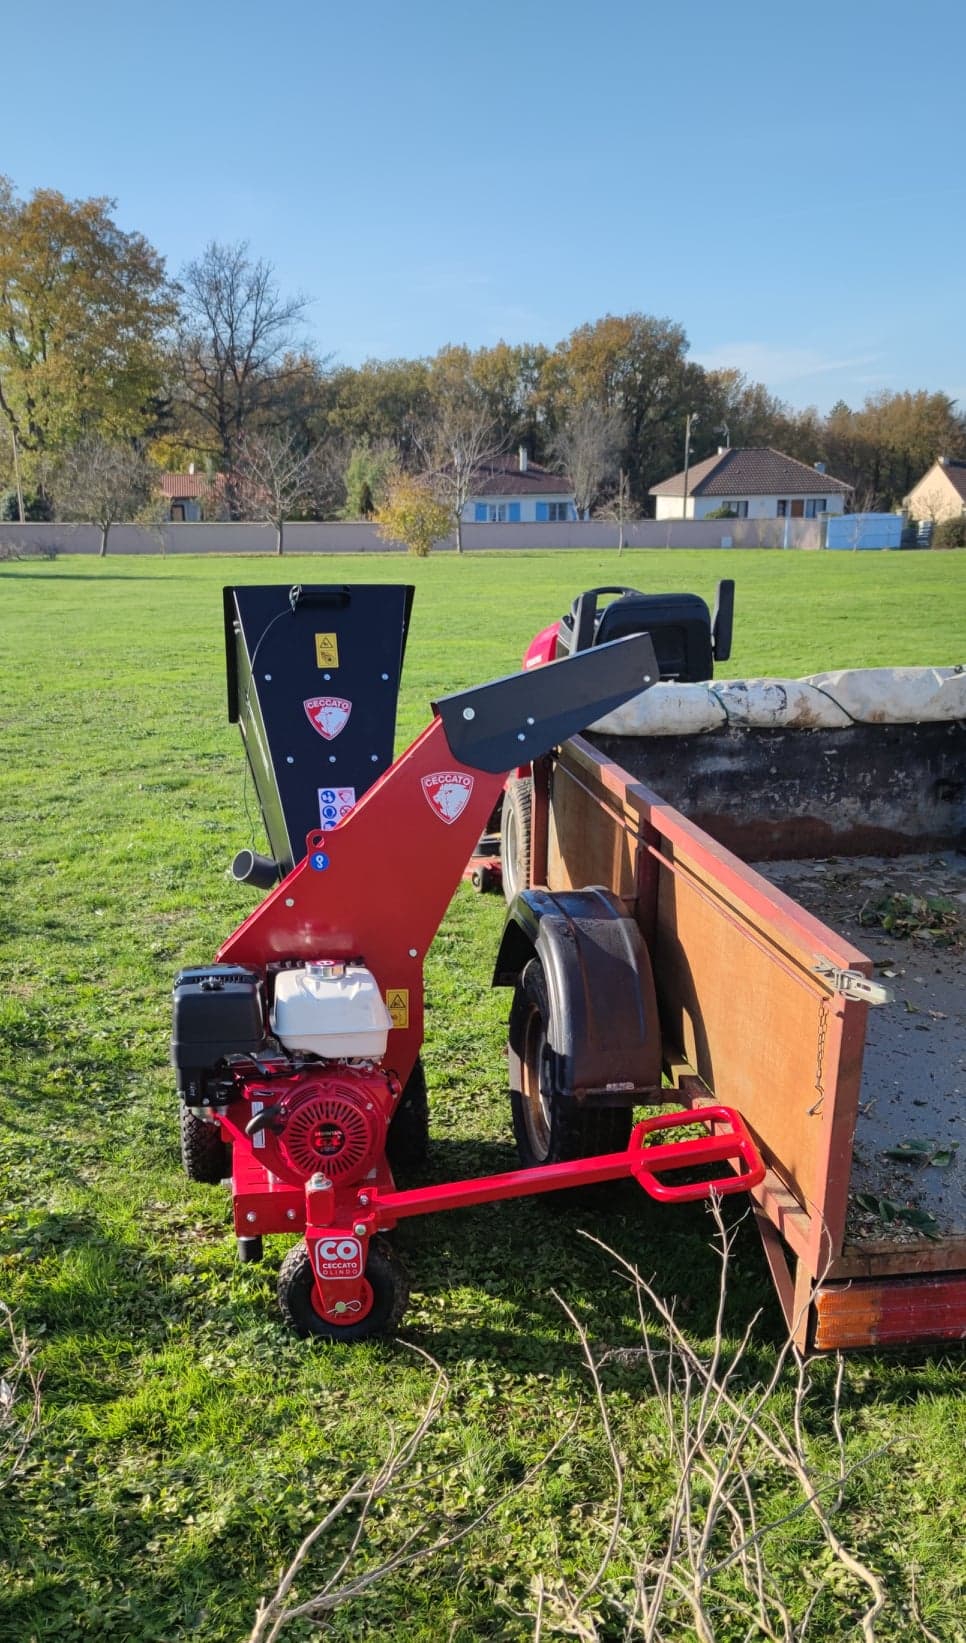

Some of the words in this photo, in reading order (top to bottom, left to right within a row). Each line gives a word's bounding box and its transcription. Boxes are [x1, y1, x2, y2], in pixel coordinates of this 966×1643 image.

[307, 699, 349, 709] CECCATO
[425, 775, 471, 787] CECCATO
[320, 1240, 358, 1261] CO
